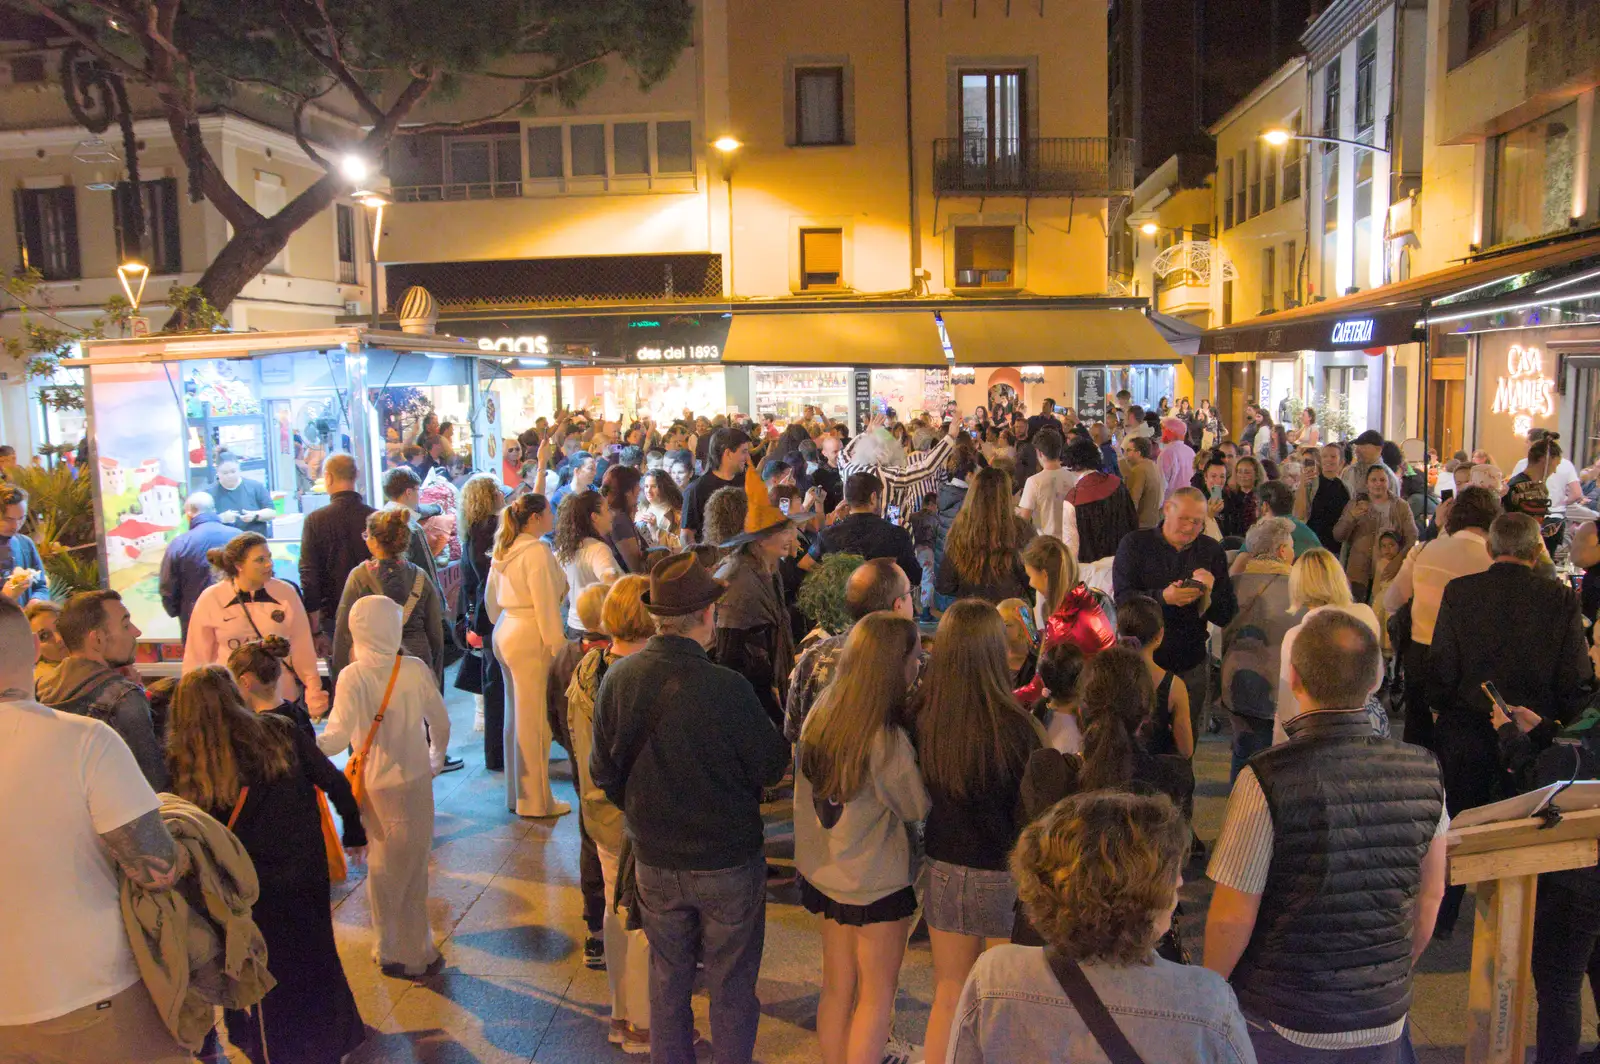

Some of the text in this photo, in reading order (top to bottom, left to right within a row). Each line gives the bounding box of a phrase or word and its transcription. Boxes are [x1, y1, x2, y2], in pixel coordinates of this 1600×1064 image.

[1331, 318, 1374, 343] CAFETERIA
[664, 346, 685, 359] del
[689, 345, 719, 359] 1893
[1261, 375, 1270, 404] JACK
